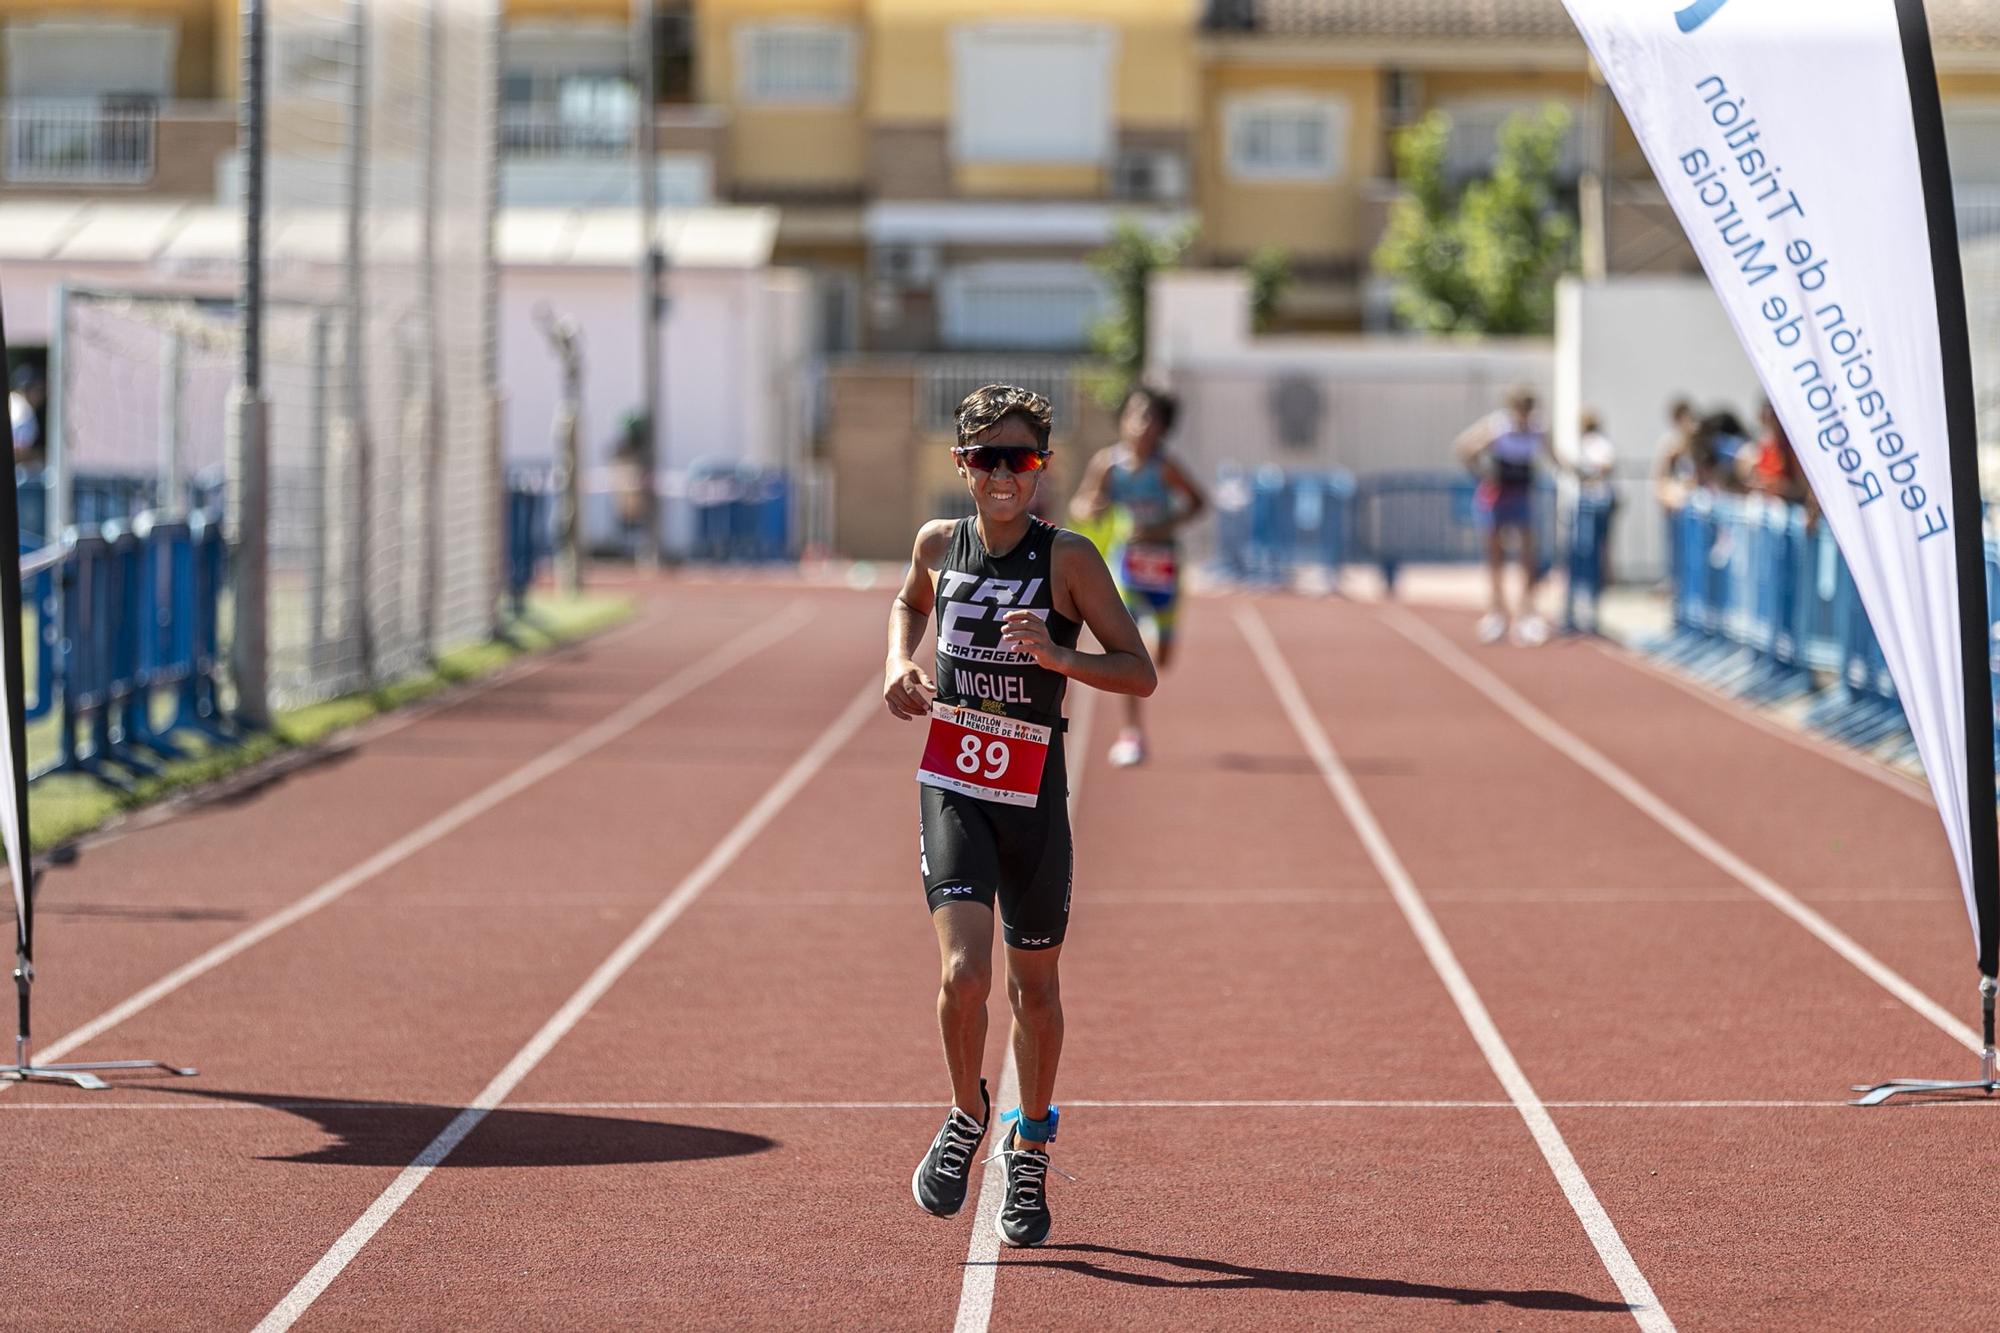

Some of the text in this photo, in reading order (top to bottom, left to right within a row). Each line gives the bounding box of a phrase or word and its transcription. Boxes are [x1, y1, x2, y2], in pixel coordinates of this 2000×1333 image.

[941, 569, 1044, 606] TRI
[954, 667, 1032, 704] MIGUEL
[965, 720, 999, 735] MENORES
[1001, 729, 1012, 737] DE
[1014, 731, 1043, 743] MOLINA
[966, 712, 1001, 727] TRIATLÓN
[955, 734, 1010, 780] 89
